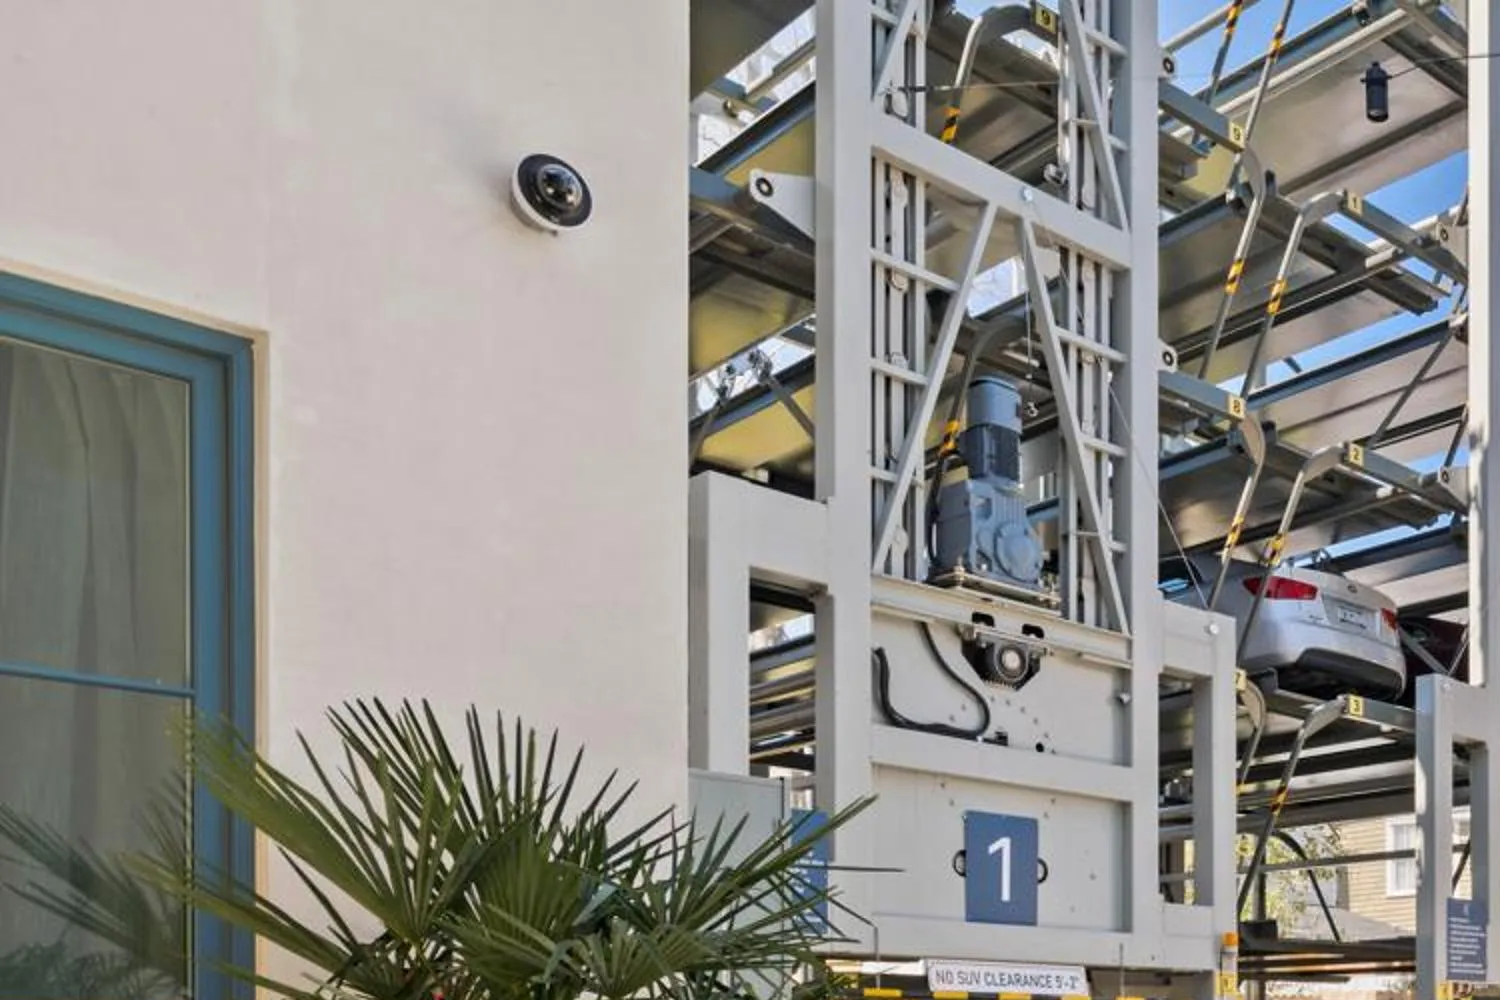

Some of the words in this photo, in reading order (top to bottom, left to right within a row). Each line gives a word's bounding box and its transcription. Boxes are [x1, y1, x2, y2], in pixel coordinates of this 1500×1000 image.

[1352, 196, 1358, 209] 1
[1233, 399, 1241, 414] 8
[1353, 447, 1360, 461] 2
[987, 836, 1011, 902] 1
[935, 969, 954, 985] NO
[957, 970, 981, 986] SUV
[983, 972, 1053, 989] CLEARANCE
